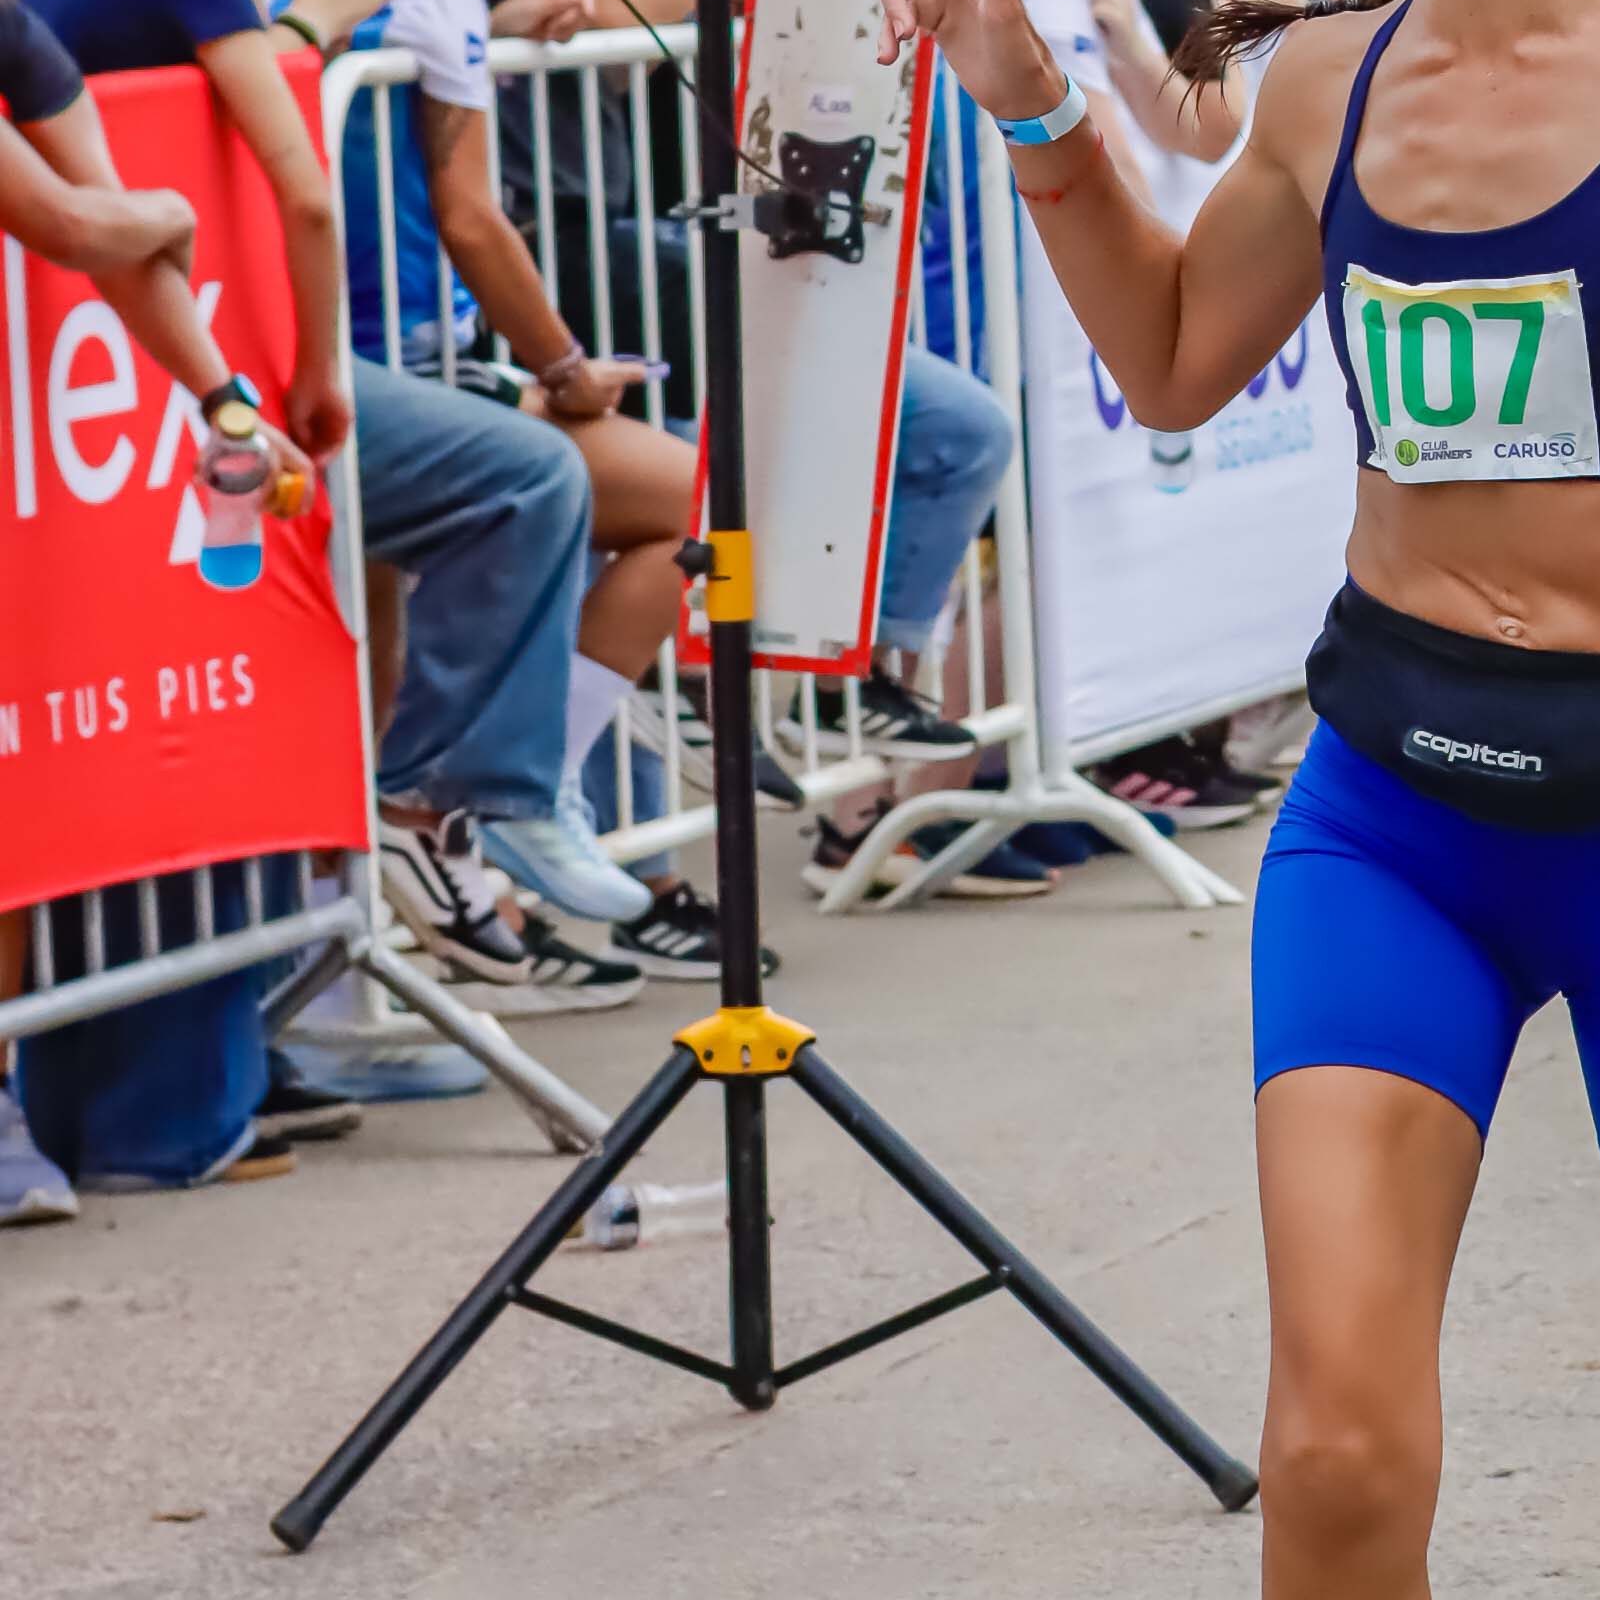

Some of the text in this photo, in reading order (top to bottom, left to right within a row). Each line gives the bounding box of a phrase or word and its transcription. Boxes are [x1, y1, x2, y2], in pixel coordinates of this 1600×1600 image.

[1362, 299, 1545, 428] 107
[1420, 449, 1473, 462] RUNNER'S
[1421, 440, 1449, 451] CLUB
[1493, 442, 1576, 459] CARUSO
[45, 675, 129, 743] TUS
[157, 652, 256, 720] PIES
[1412, 729, 1543, 772] capitán
